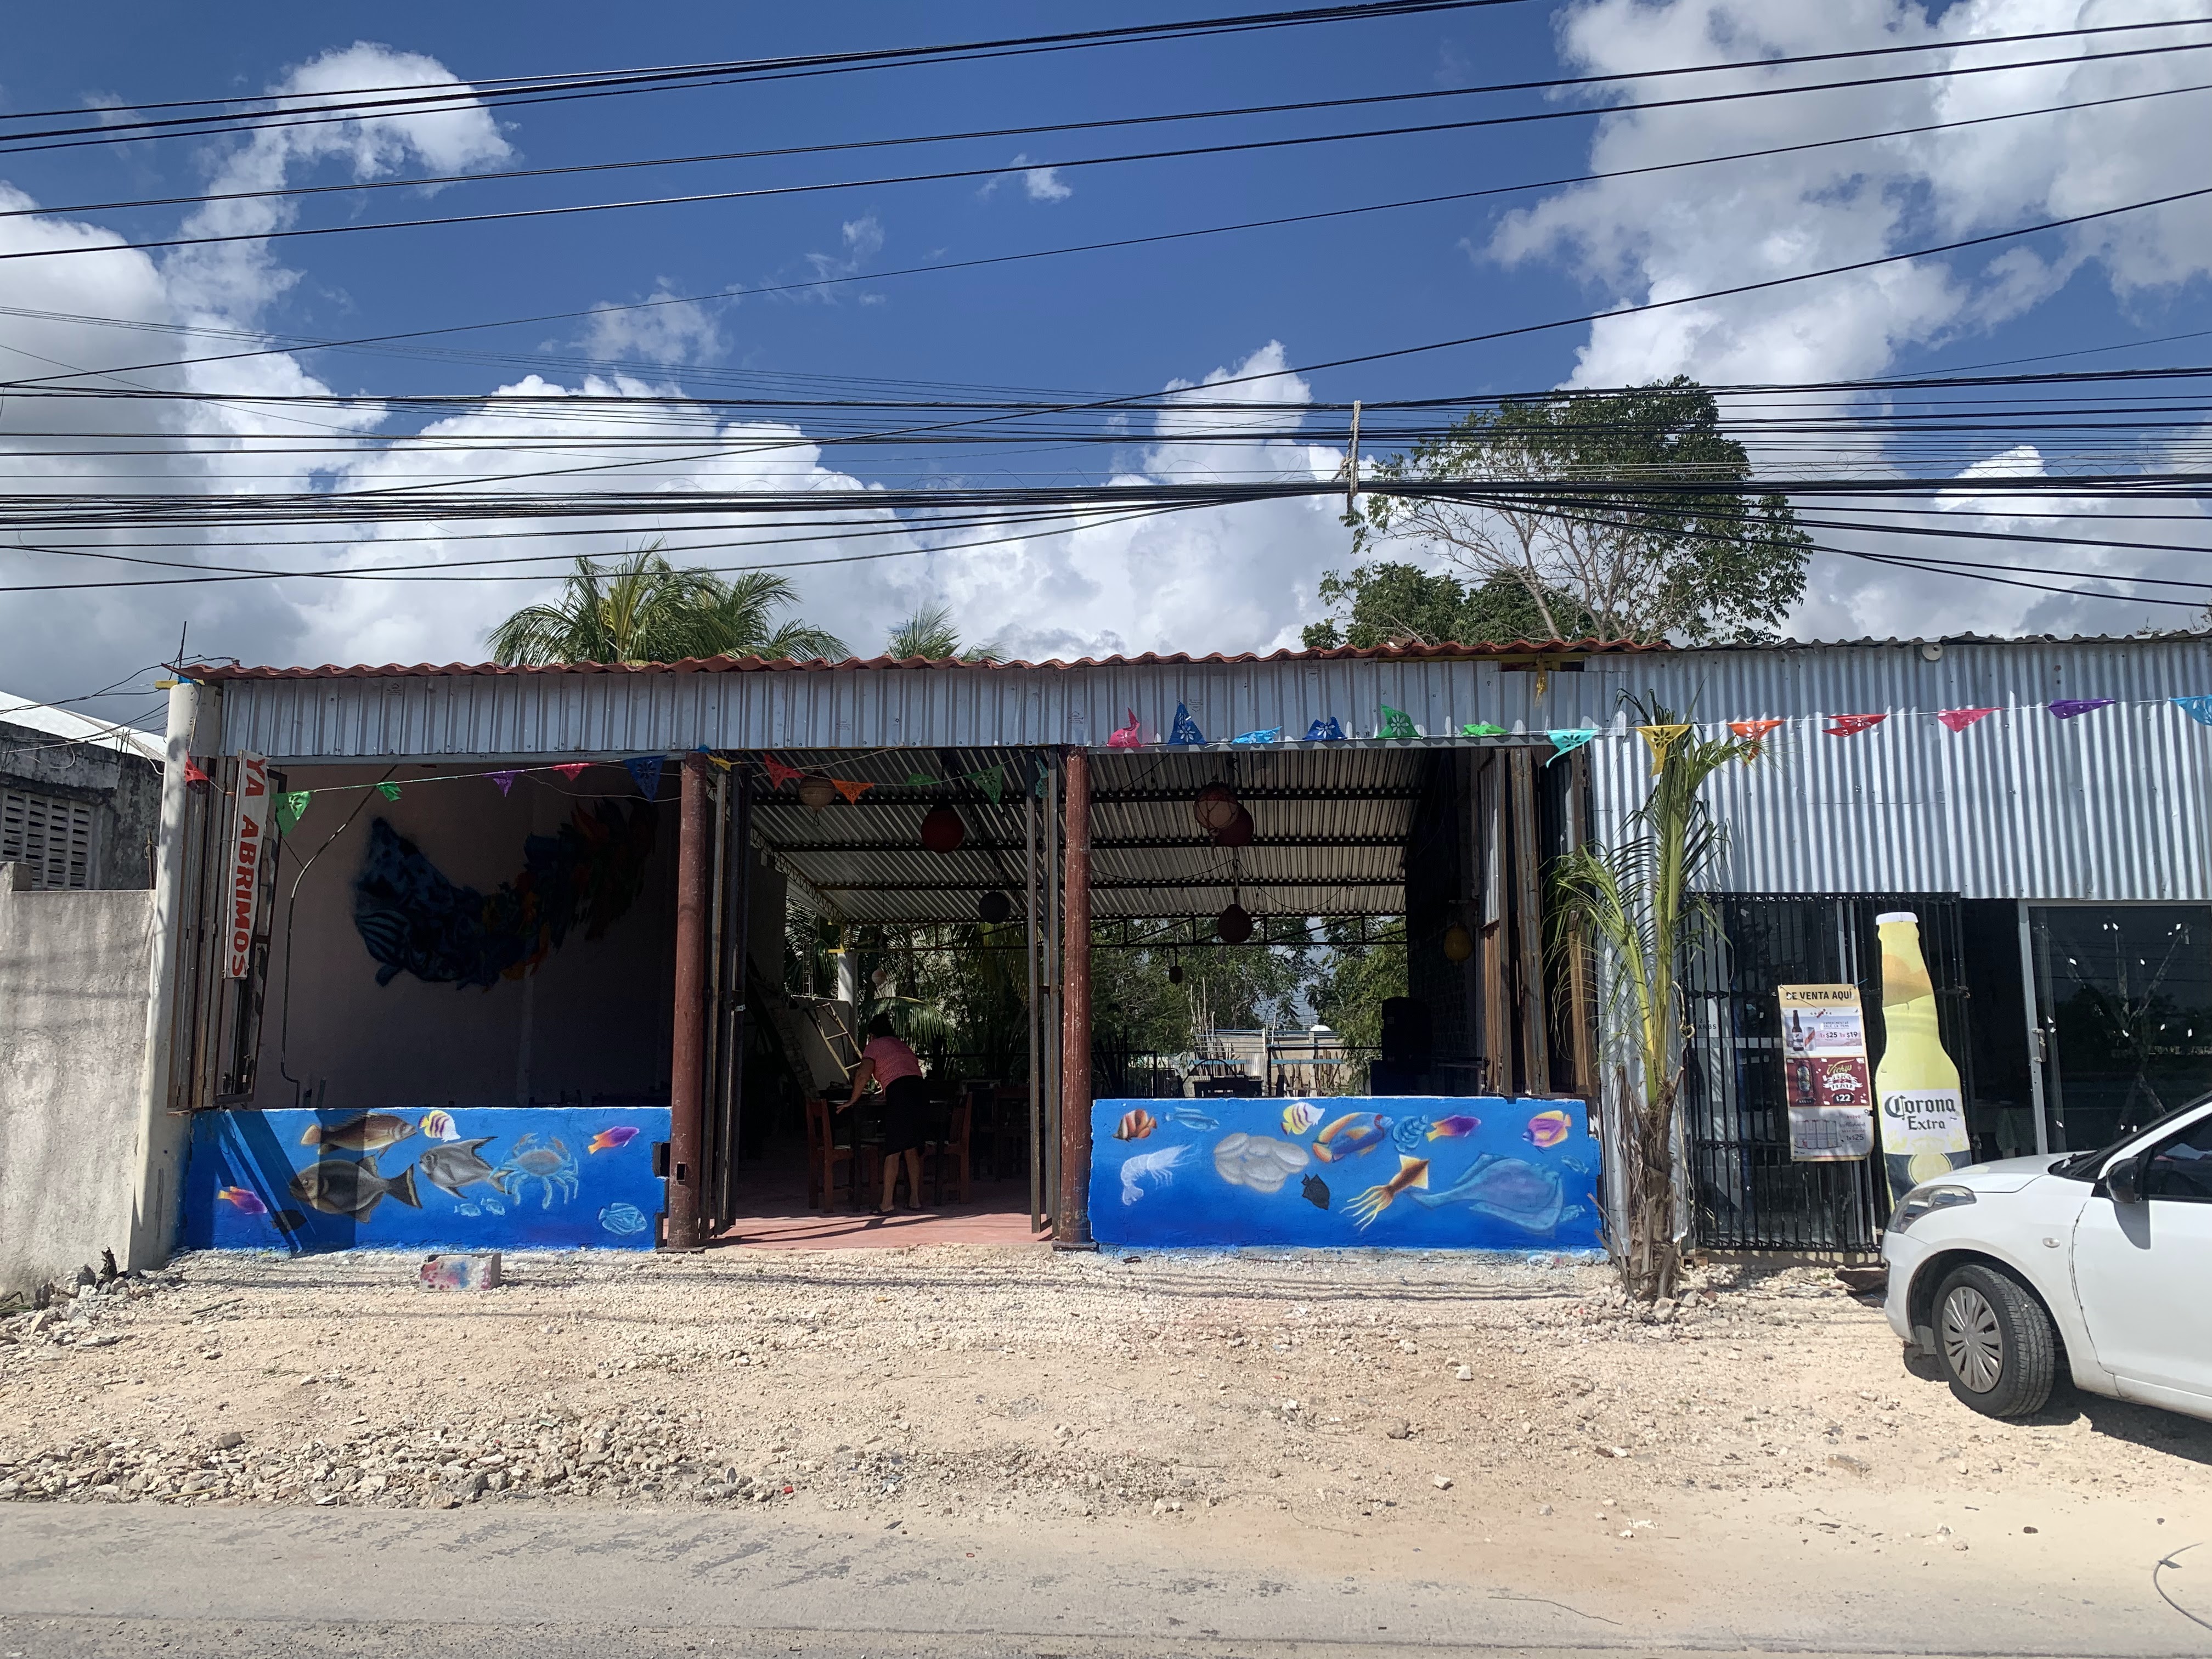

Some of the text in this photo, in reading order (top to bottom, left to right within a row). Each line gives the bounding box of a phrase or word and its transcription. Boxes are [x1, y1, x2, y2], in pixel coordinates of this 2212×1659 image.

[232, 758, 266, 977] YA ABRIMOS
[1800, 991, 1829, 1000] VENTA
[1832, 988, 1852, 1001] AQUÍ
[1836, 1094, 1851, 1103] $22
[1884, 1095, 1957, 1120] Corona
[1908, 1116, 1946, 1130] Extra
